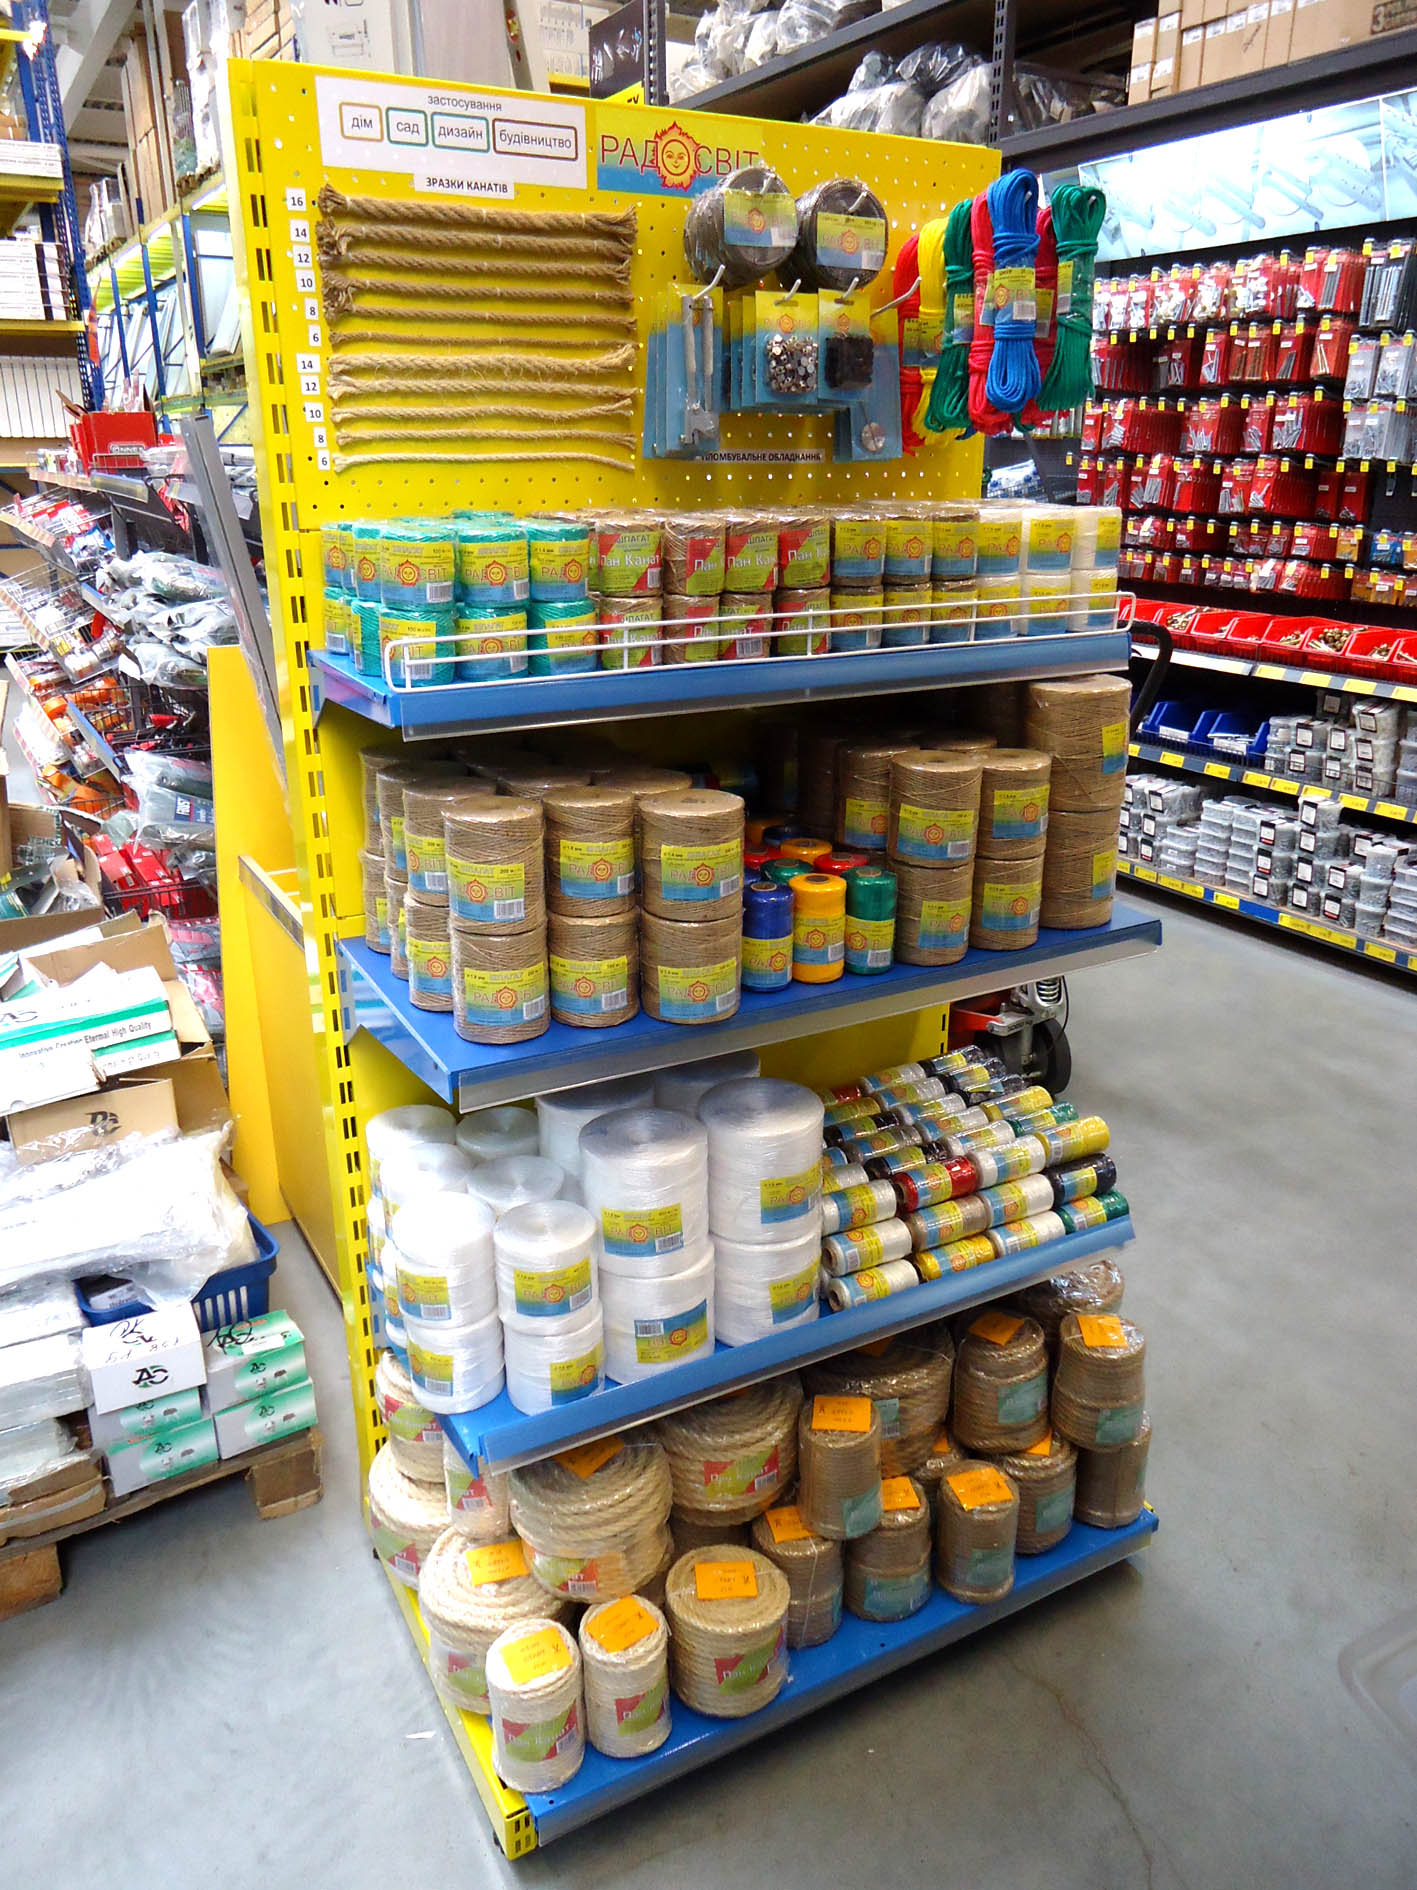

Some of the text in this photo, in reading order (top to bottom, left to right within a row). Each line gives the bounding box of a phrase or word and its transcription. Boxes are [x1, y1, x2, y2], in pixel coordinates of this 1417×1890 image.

[427, 95, 502, 112] застосування
[351, 116, 373, 130] дім
[396, 121, 420, 136] сад
[438, 124, 483, 140] дизайн
[499, 129, 572, 150] будівництво
[425, 178, 509, 194] ЗРАЗКИ КАНАТІВ
[290, 196, 303, 207] 16
[295, 228, 307, 238] 14
[297, 253, 310, 263] 12
[301, 278, 313, 288] 10
[309, 306, 316, 316] 8
[313, 333, 319, 342] 6
[301, 360, 313, 369] 14
[305, 382, 317, 391] 12
[309, 409, 321, 418] 10
[317, 434, 324, 443] 8
[321, 456, 328, 466] 6
[111, 1027, 127, 1038] High
[128, 1021, 152, 1033] Quality
